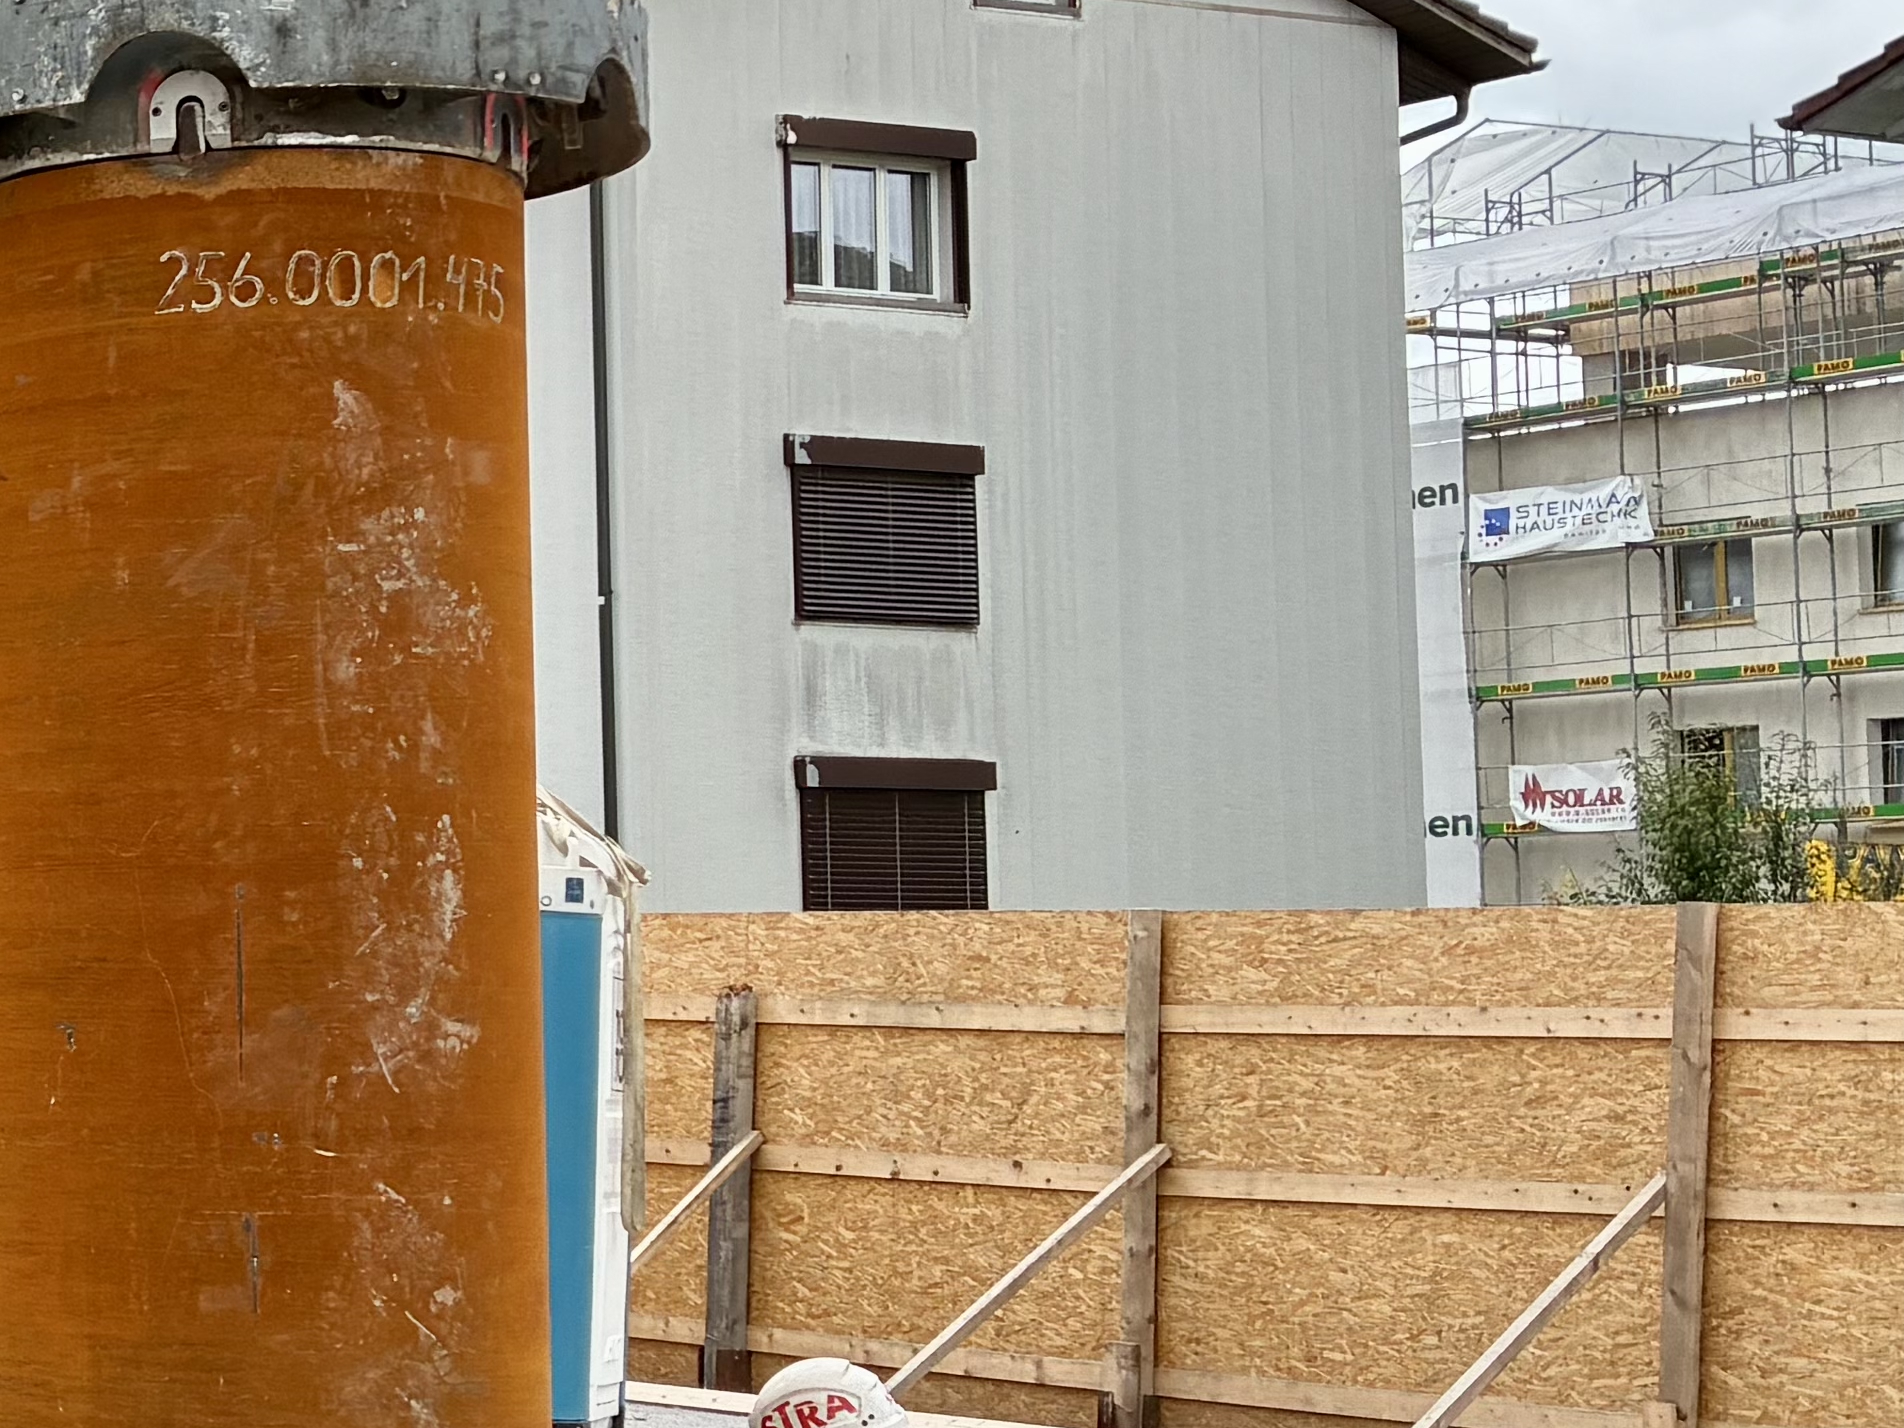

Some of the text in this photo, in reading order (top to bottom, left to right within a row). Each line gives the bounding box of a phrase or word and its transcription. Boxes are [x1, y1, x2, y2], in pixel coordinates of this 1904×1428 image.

[1664, 286, 1696, 298] PAMO
[1816, 361, 1851, 373] PAMO
[1729, 373, 1762, 385] PAMO
[1647, 386, 1679, 397] PAMO
[1411, 481, 1459, 510] en
[1823, 508, 1857, 520] PAMO
[1736, 518, 1769, 530] PAMO
[1831, 655, 1864, 668] PAMO
[1743, 663, 1776, 675] PAMO
[1578, 675, 1610, 687] PAMO
[1660, 670, 1692, 682] PAMO
[1500, 683, 1530, 695] PAMO
[1424, 812, 1474, 839] en
